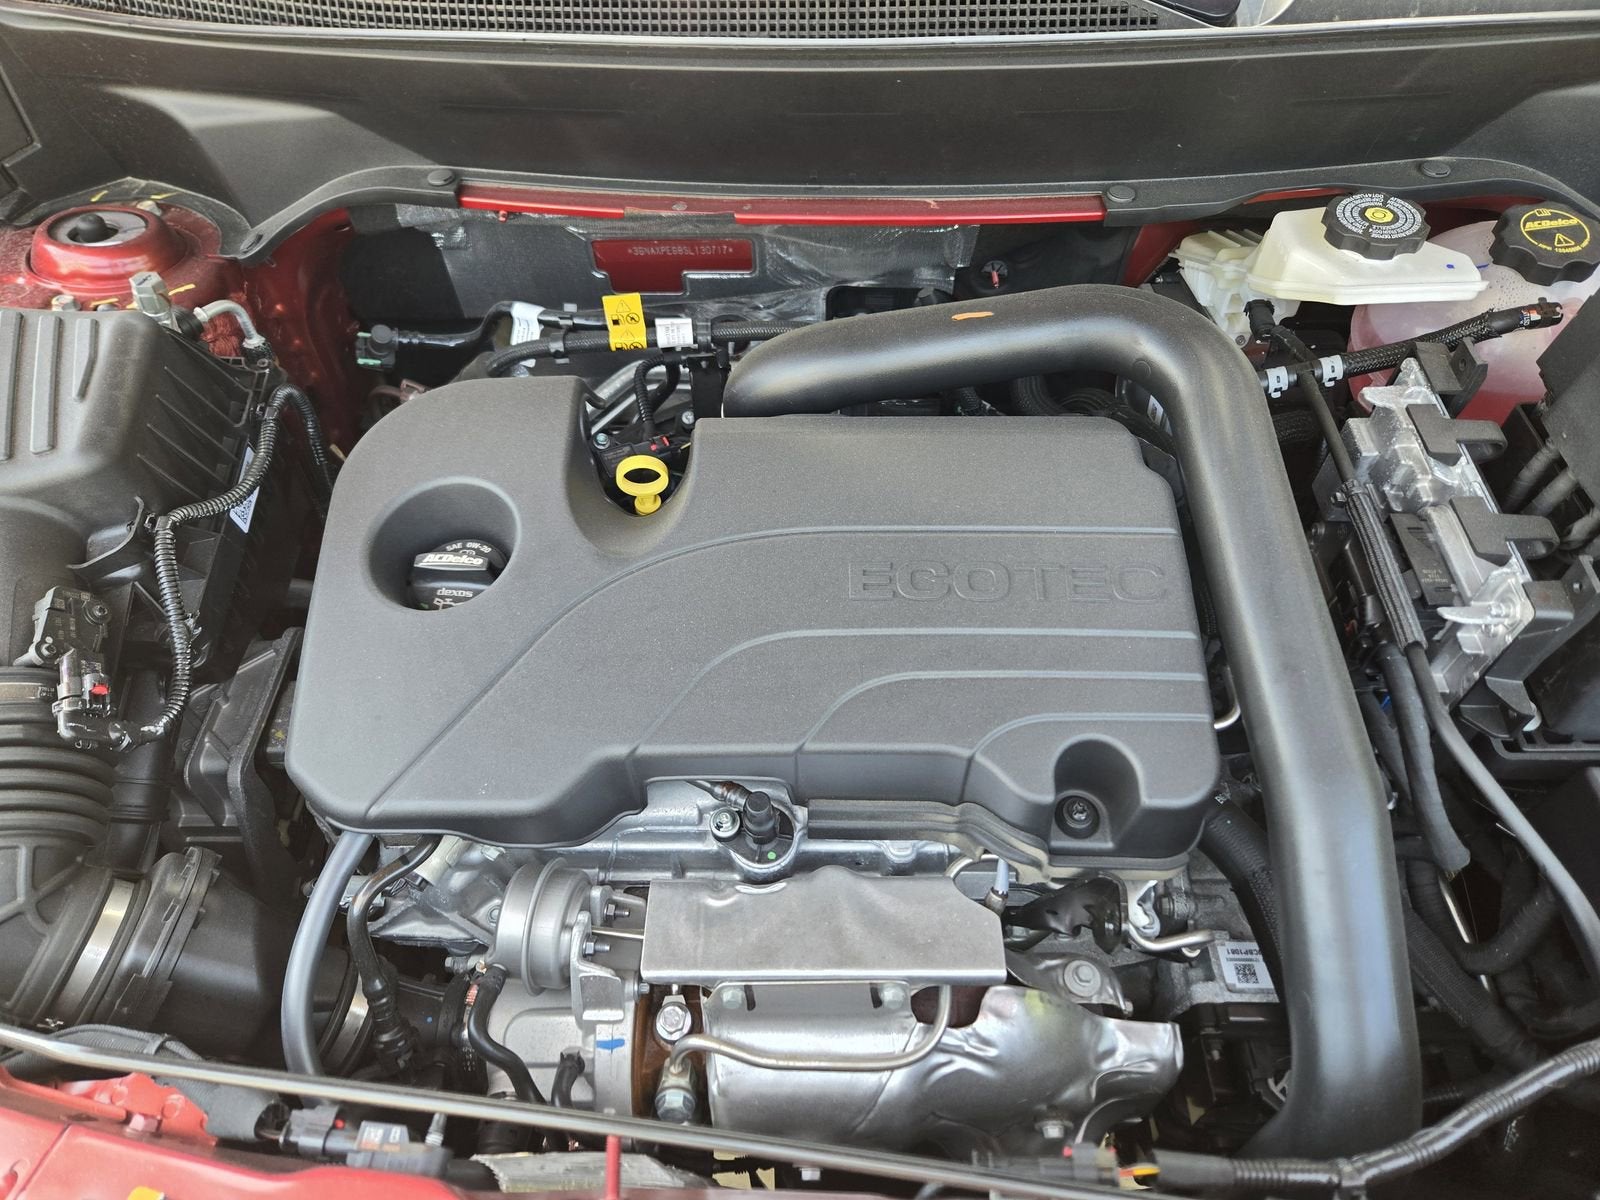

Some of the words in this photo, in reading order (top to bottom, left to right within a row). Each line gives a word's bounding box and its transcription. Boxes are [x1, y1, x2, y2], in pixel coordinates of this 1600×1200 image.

[1525, 218, 1578, 229] ACDelco
[446, 542, 463, 551] SAE
[466, 542, 492, 553] 0W-20
[422, 553, 484, 565] ACDelco
[849, 560, 1165, 602] ECOTEC
[436, 587, 473, 598] dexos
